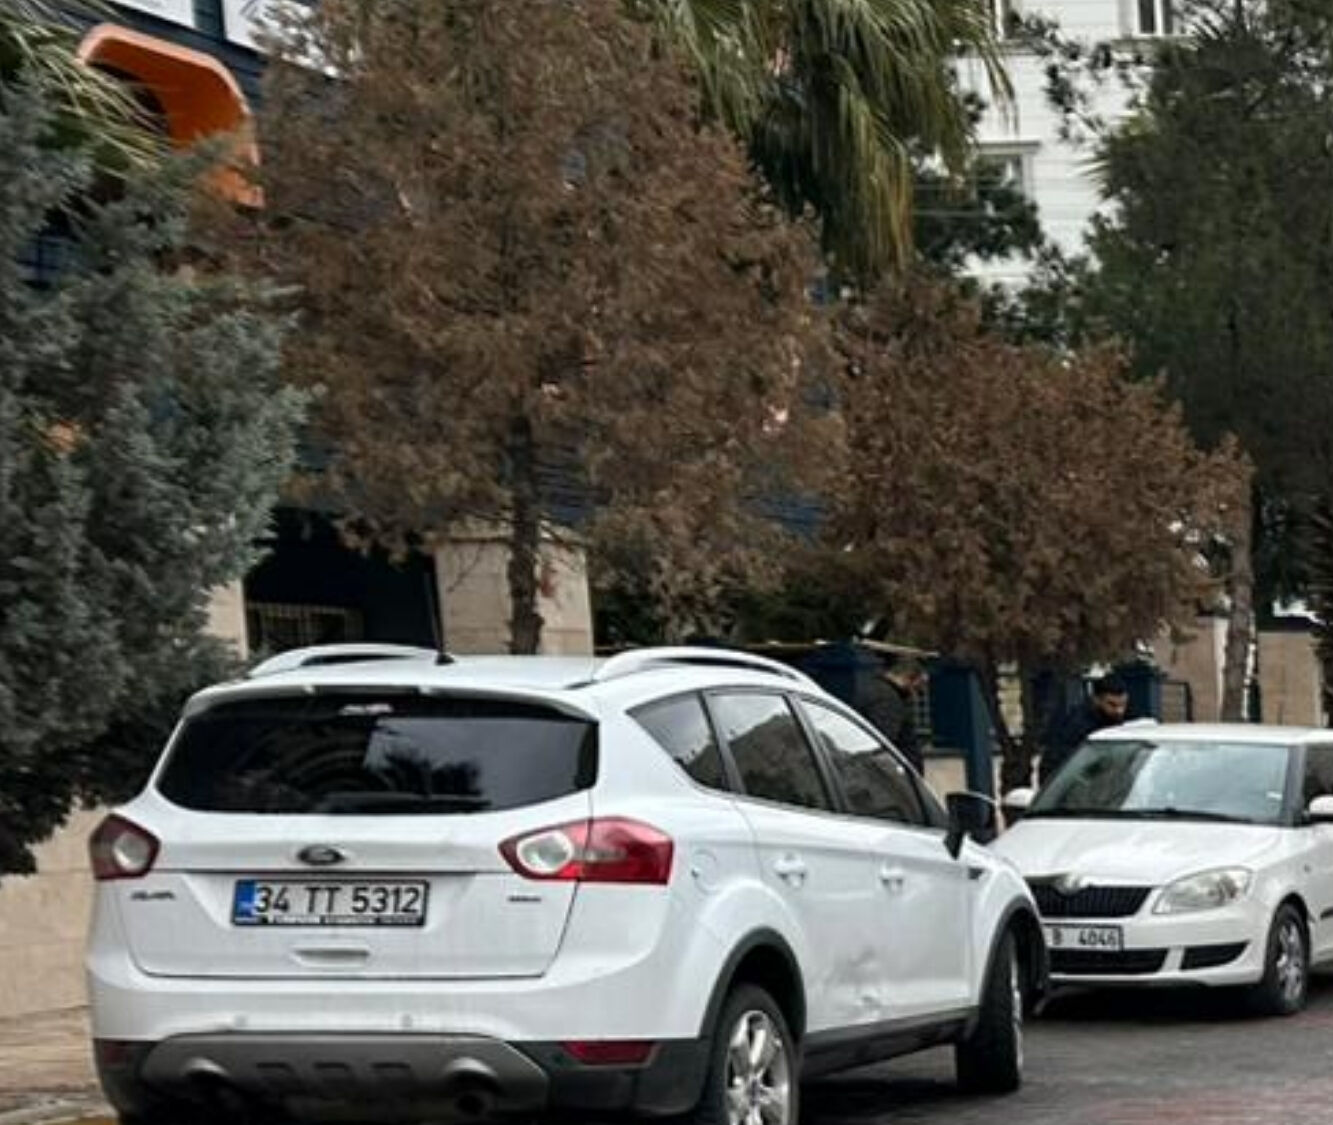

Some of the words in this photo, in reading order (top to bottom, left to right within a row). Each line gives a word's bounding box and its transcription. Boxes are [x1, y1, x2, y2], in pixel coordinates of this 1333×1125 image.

[256, 886, 290, 913] 34
[305, 886, 341, 913] TT
[351, 886, 420, 913] 5312
